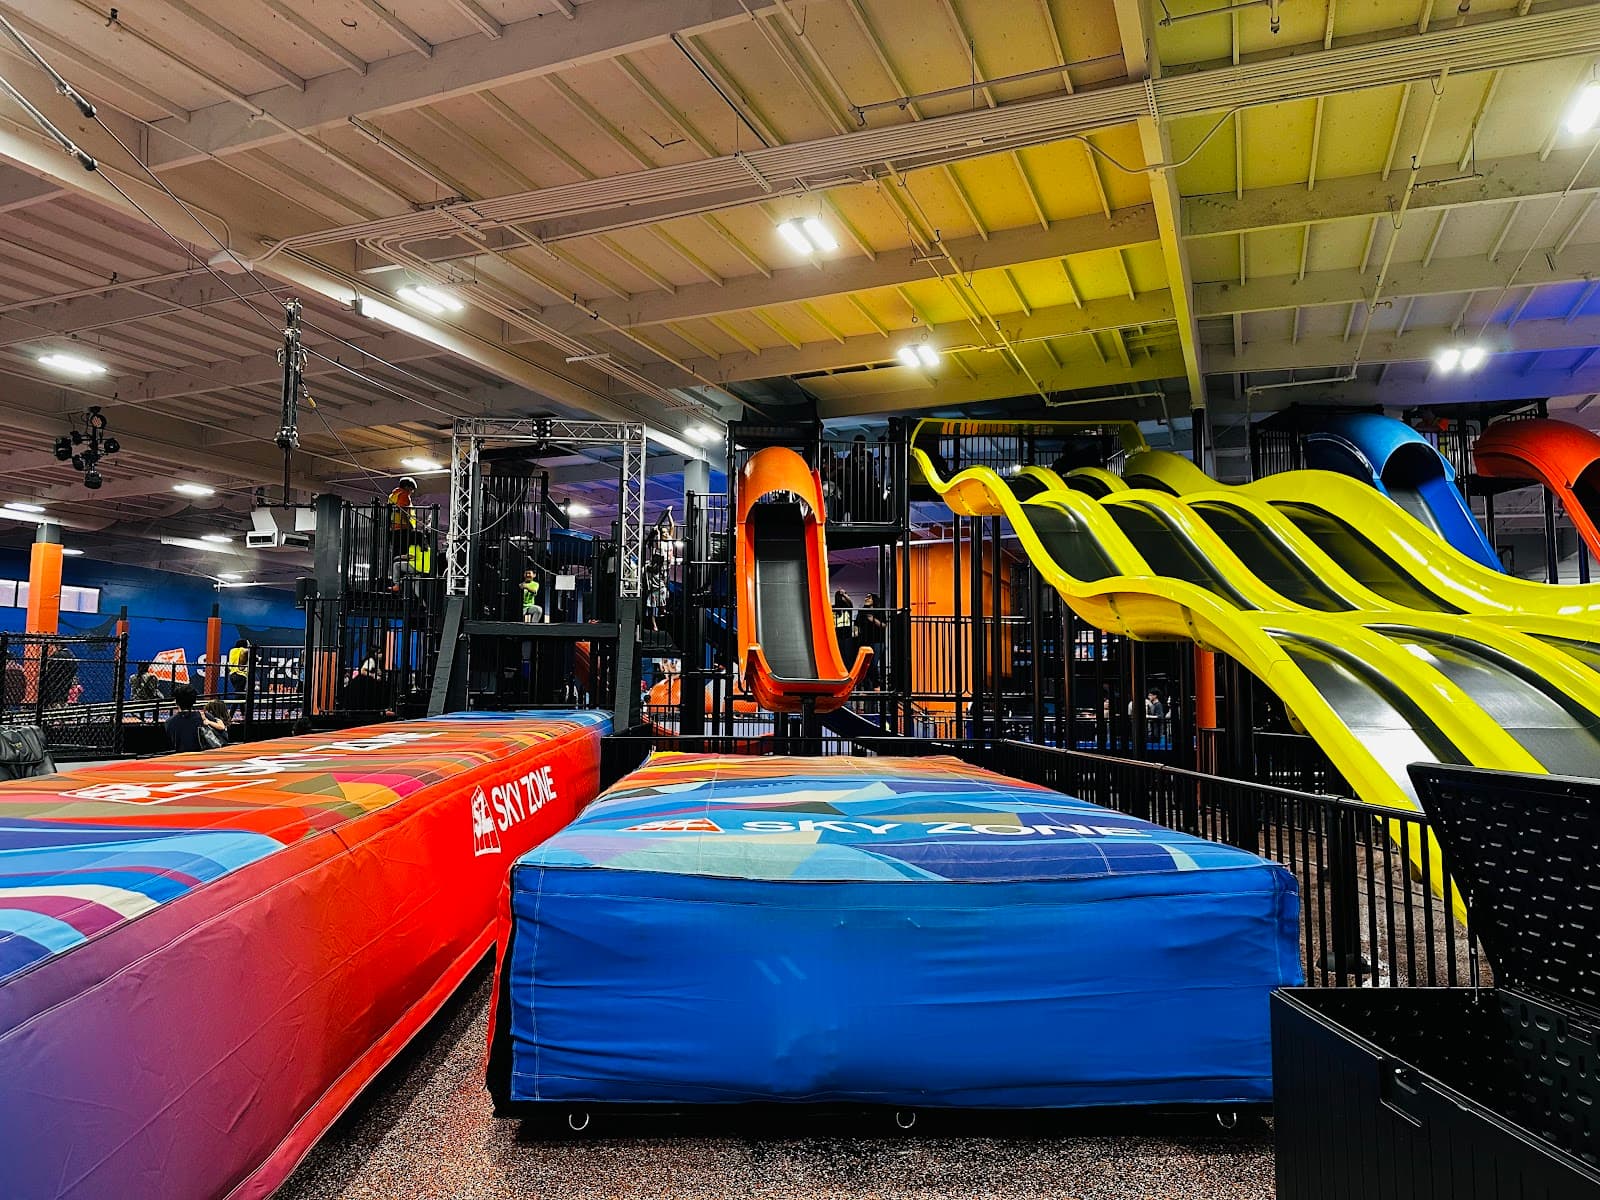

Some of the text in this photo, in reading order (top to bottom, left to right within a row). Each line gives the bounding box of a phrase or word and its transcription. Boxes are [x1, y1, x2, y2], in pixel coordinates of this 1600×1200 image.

[491, 766, 557, 832] SKY ZONE
[742, 819, 1152, 837] SKY ZONE
